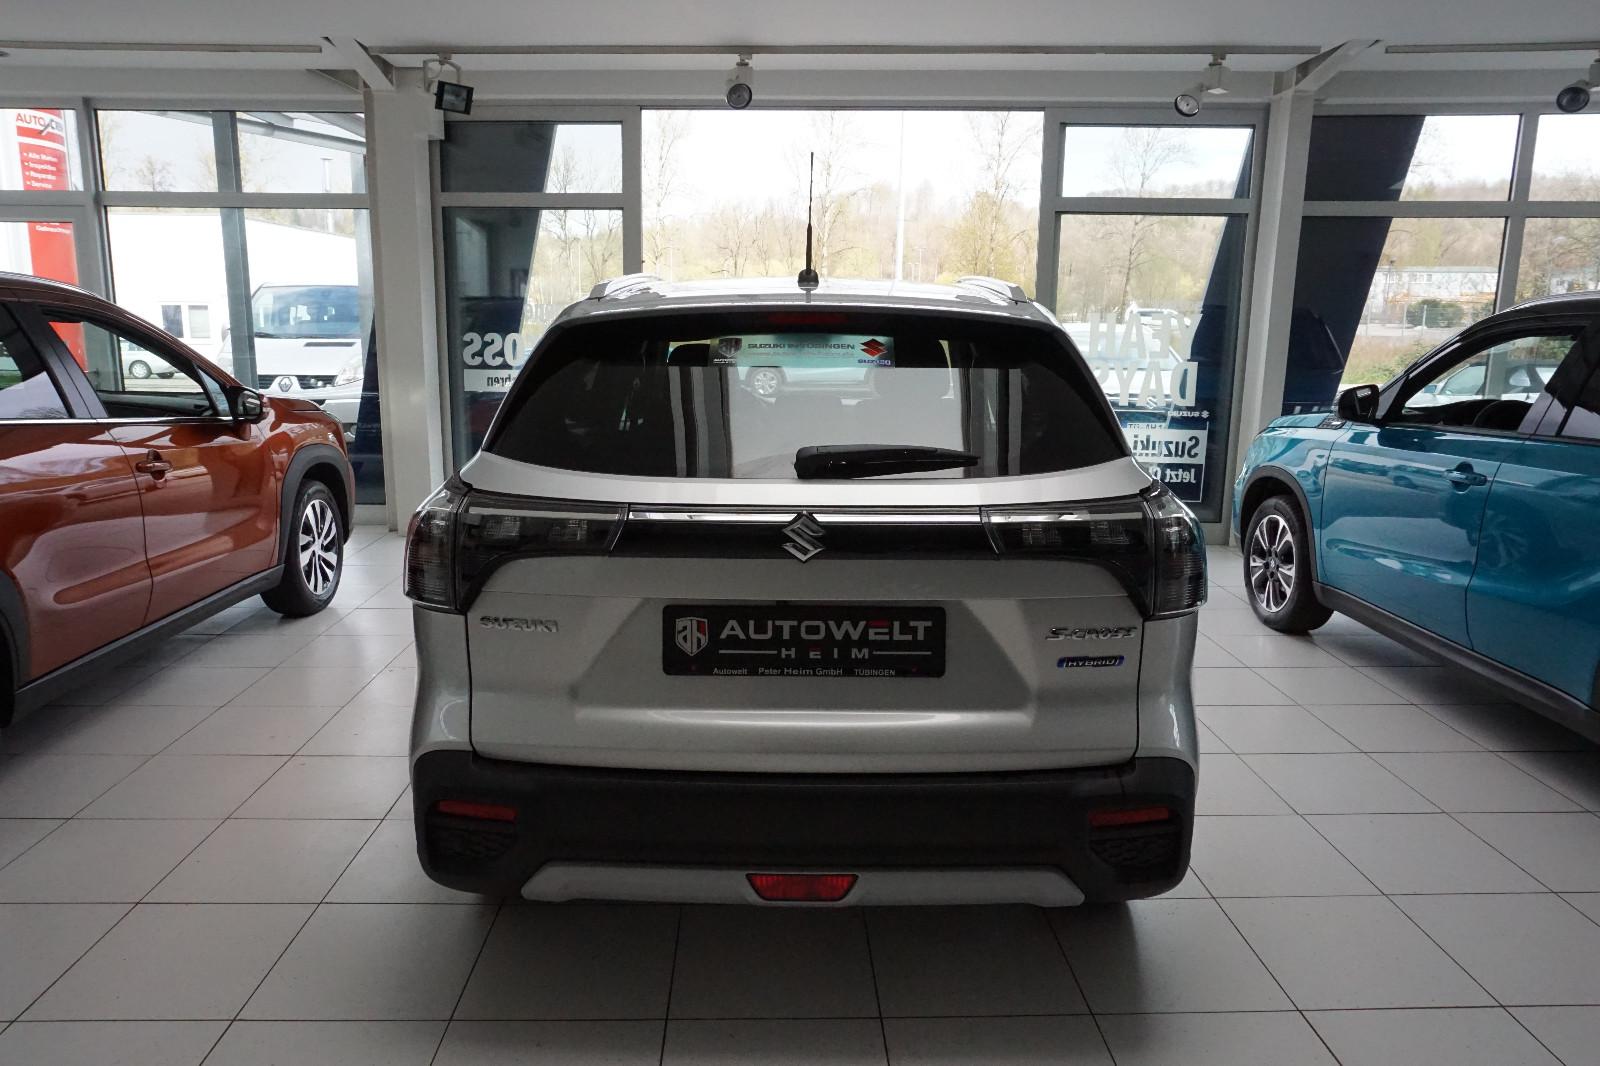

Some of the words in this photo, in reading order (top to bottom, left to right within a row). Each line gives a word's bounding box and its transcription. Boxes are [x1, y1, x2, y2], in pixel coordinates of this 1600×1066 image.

[480, 616, 559, 633] SUZUKI
[719, 619, 932, 640] AUTOWELT
[781, 645, 869, 659] HEIM
[1067, 658, 1116, 667] HYBRID
[713, 667, 748, 675] Autowelt
[758, 667, 781, 675] Peter
[784, 667, 813, 676] Heim
[815, 667, 843, 676] GmbH
